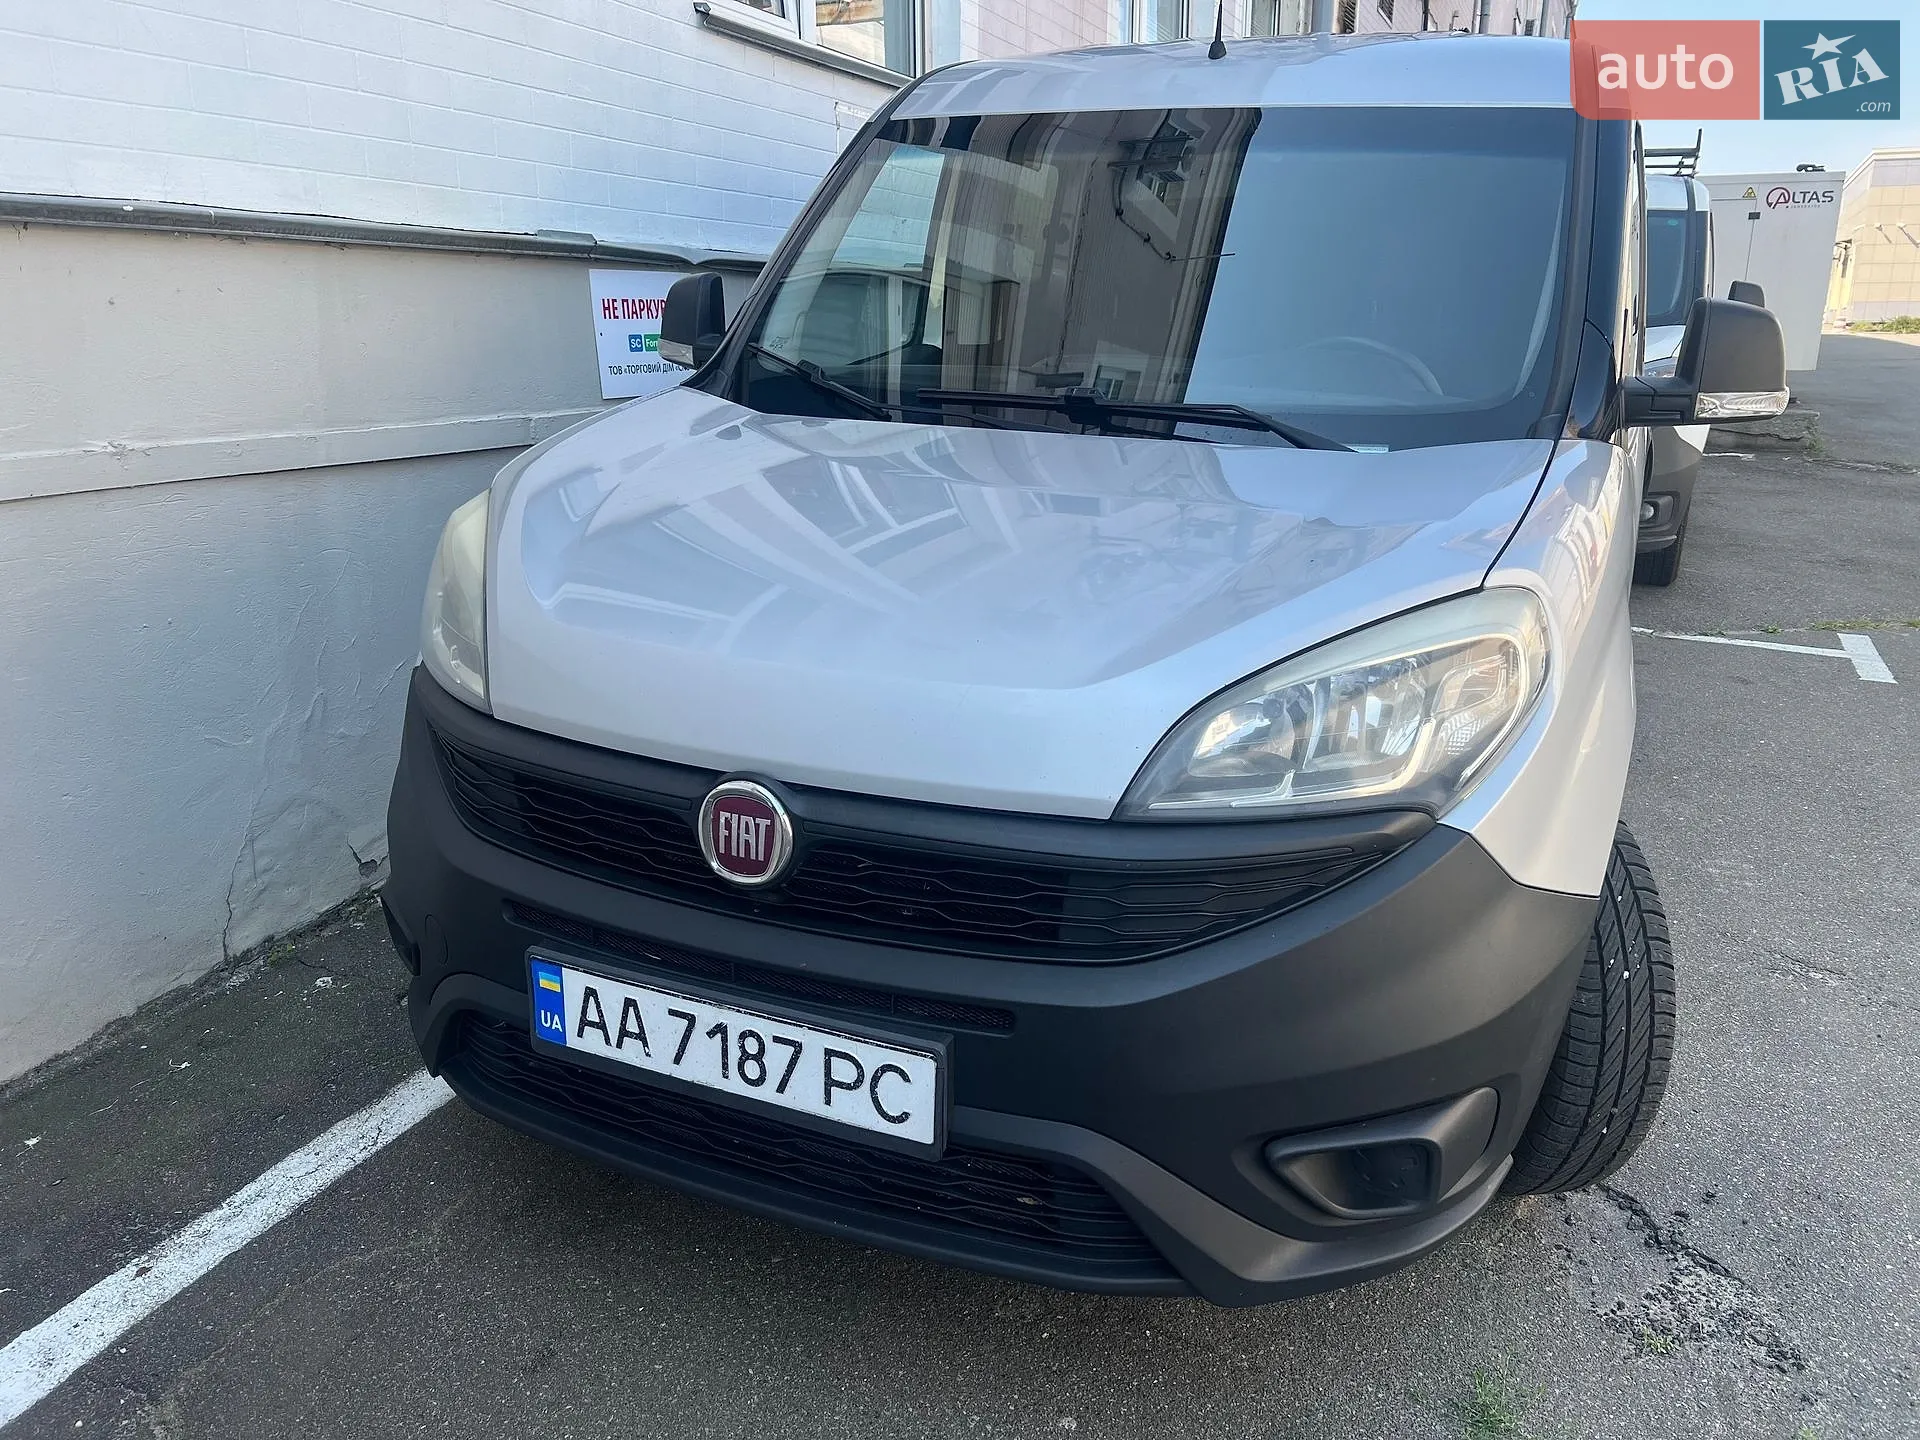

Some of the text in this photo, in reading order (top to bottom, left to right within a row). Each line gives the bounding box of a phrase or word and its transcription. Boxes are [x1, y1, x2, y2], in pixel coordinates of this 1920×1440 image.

[1766, 187, 1834, 209] ALTAS
[602, 299, 619, 319] НЕ
[630, 338, 642, 348] SC
[608, 365, 622, 376] ТОВ
[719, 810, 771, 862] FIAT
[541, 1010, 562, 1033] UA
[576, 986, 913, 1125] AA 7187 PC
